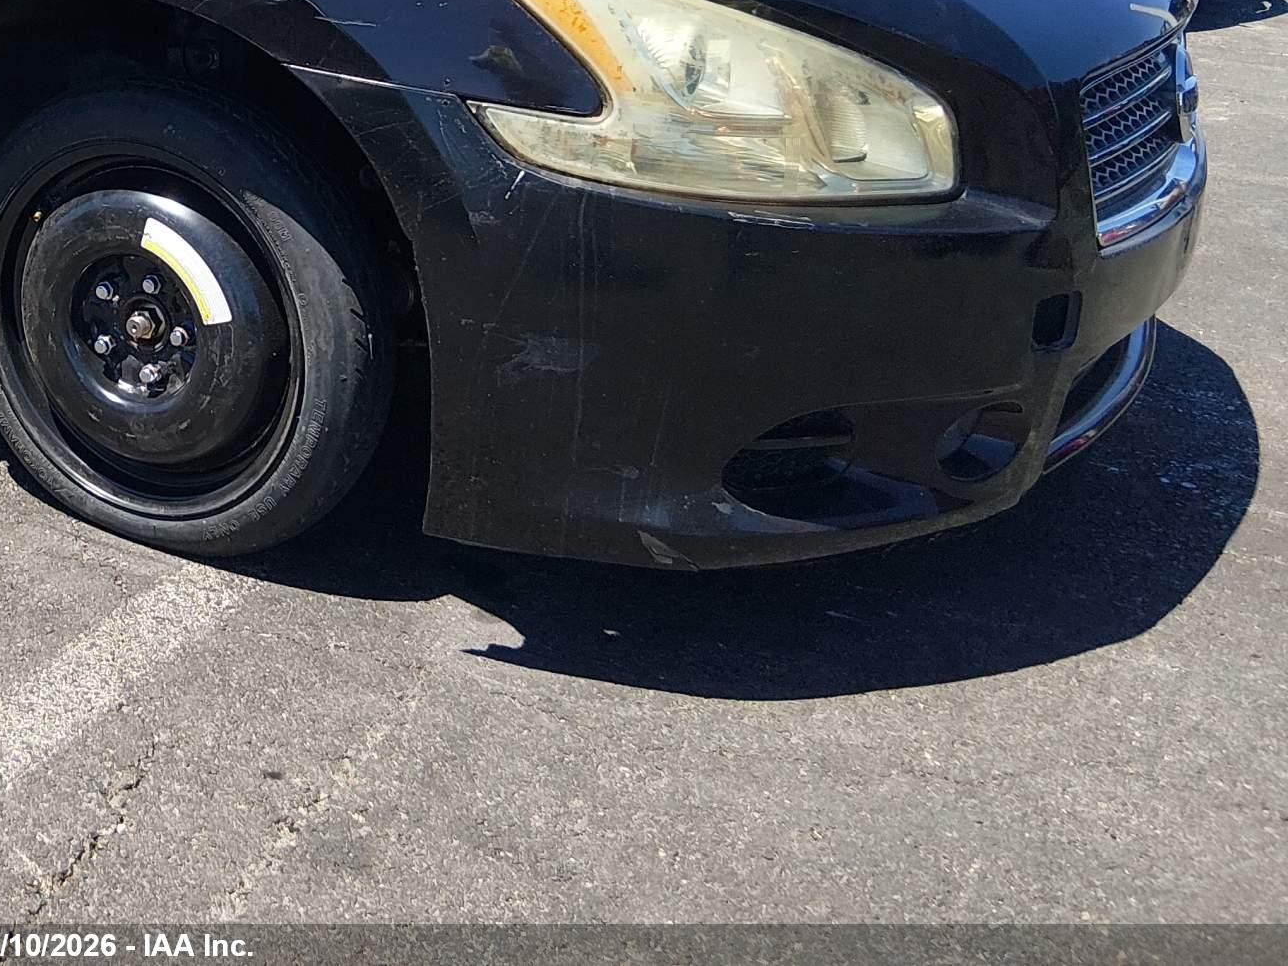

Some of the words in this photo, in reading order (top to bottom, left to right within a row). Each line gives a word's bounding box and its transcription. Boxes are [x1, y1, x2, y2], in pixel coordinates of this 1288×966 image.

[278, 397, 328, 497] TEMPORARY
[247, 495, 278, 521] USE
[201, 518, 241, 540] ONLY
